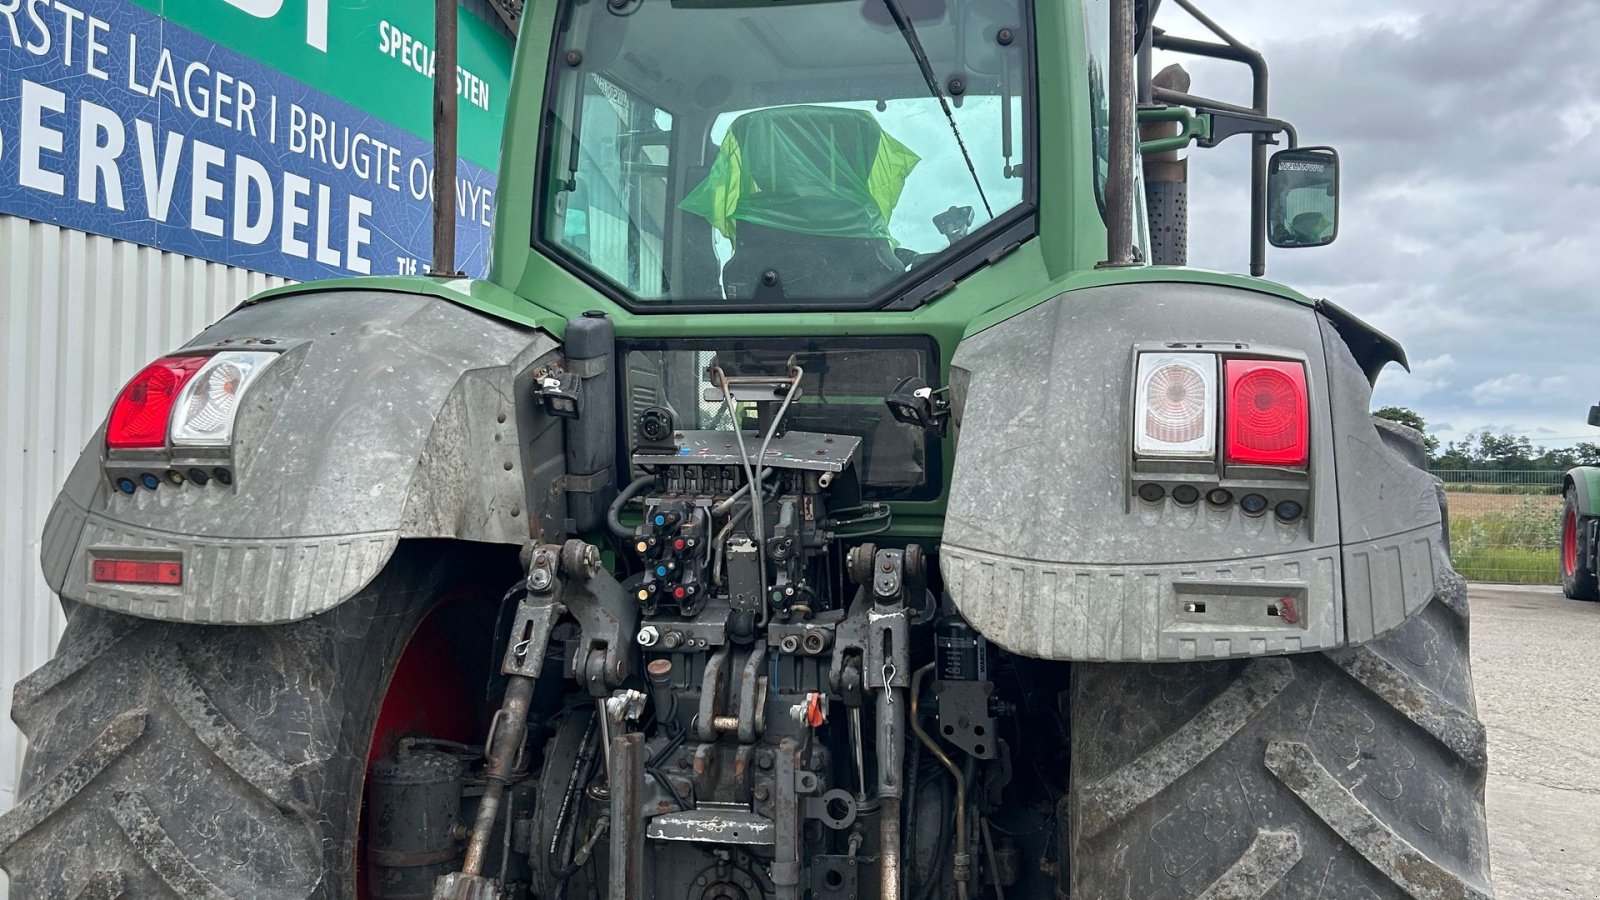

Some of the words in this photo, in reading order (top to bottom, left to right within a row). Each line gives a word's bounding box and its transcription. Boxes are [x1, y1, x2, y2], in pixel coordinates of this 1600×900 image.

[129, 33, 256, 137] LAGER
[270, 94, 277, 144] I
[290, 103, 401, 191] BRUGTE
[409, 157, 434, 202] O
[380, 20, 489, 111] SPECIASTEN
[0, 78, 372, 275] ERVEDELE
